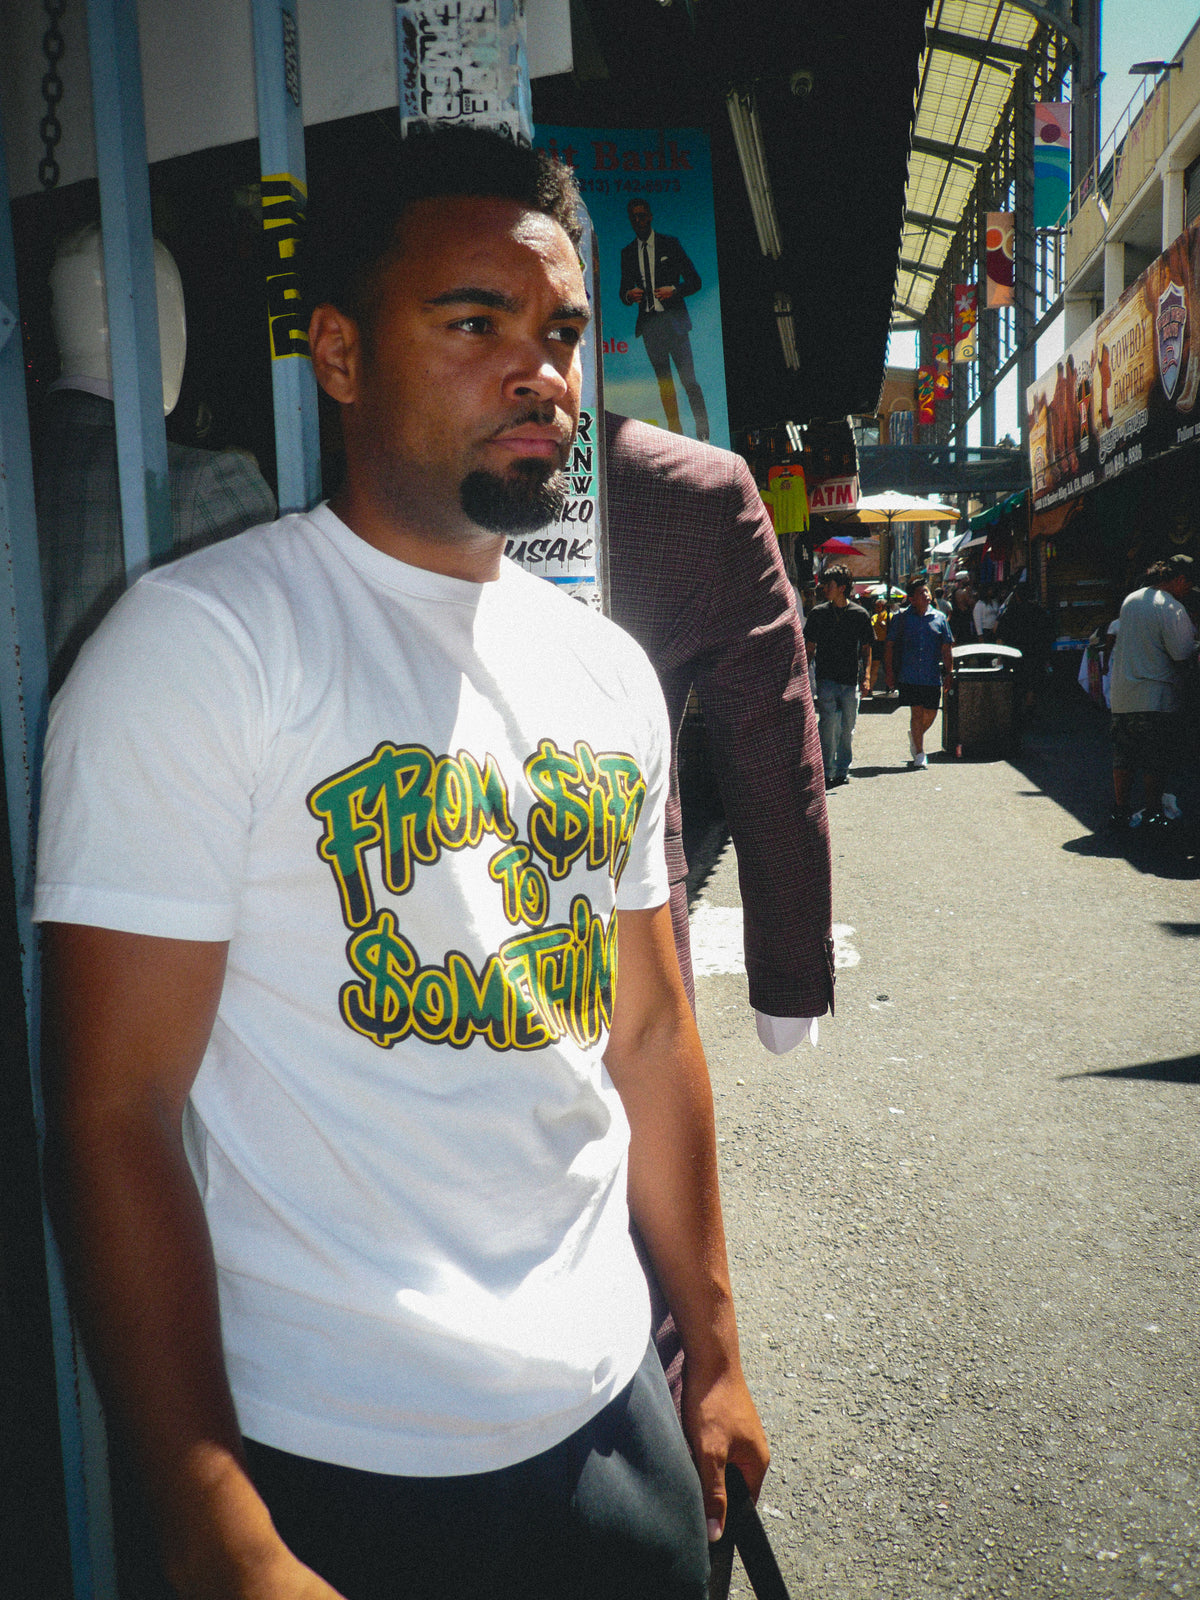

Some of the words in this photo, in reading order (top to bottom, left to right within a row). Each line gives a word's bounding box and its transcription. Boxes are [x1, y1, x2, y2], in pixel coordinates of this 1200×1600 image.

[591, 140, 693, 171] Bank
[1111, 319, 1147, 372] COWBOY
[1114, 362, 1145, 411] EMPIRE
[812, 484, 853, 507] ATM
[306, 740, 516, 931] FROM
[489, 841, 550, 929] TO
